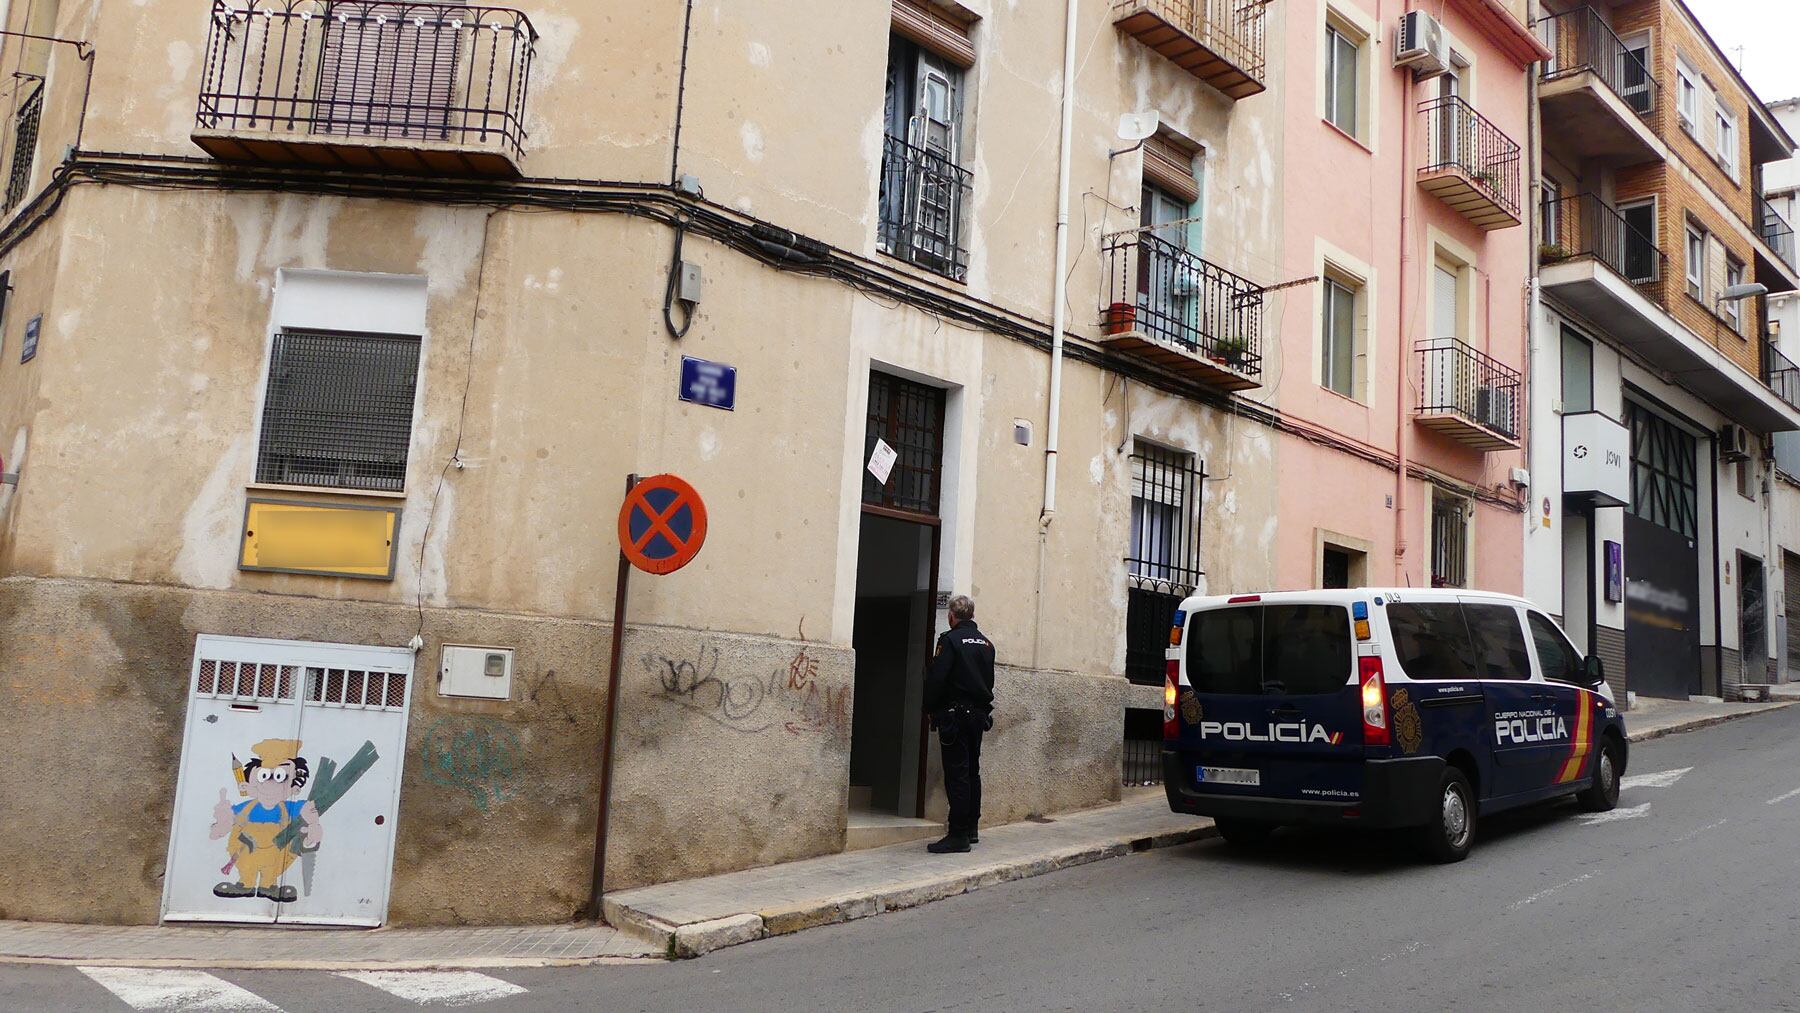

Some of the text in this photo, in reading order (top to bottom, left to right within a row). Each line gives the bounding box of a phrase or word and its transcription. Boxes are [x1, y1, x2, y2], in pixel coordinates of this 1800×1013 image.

[1519, 710, 1543, 718] NACIONAL
[1200, 719, 1331, 743] POLICÍA
[1301, 788, 1360, 797] www.policia.es
